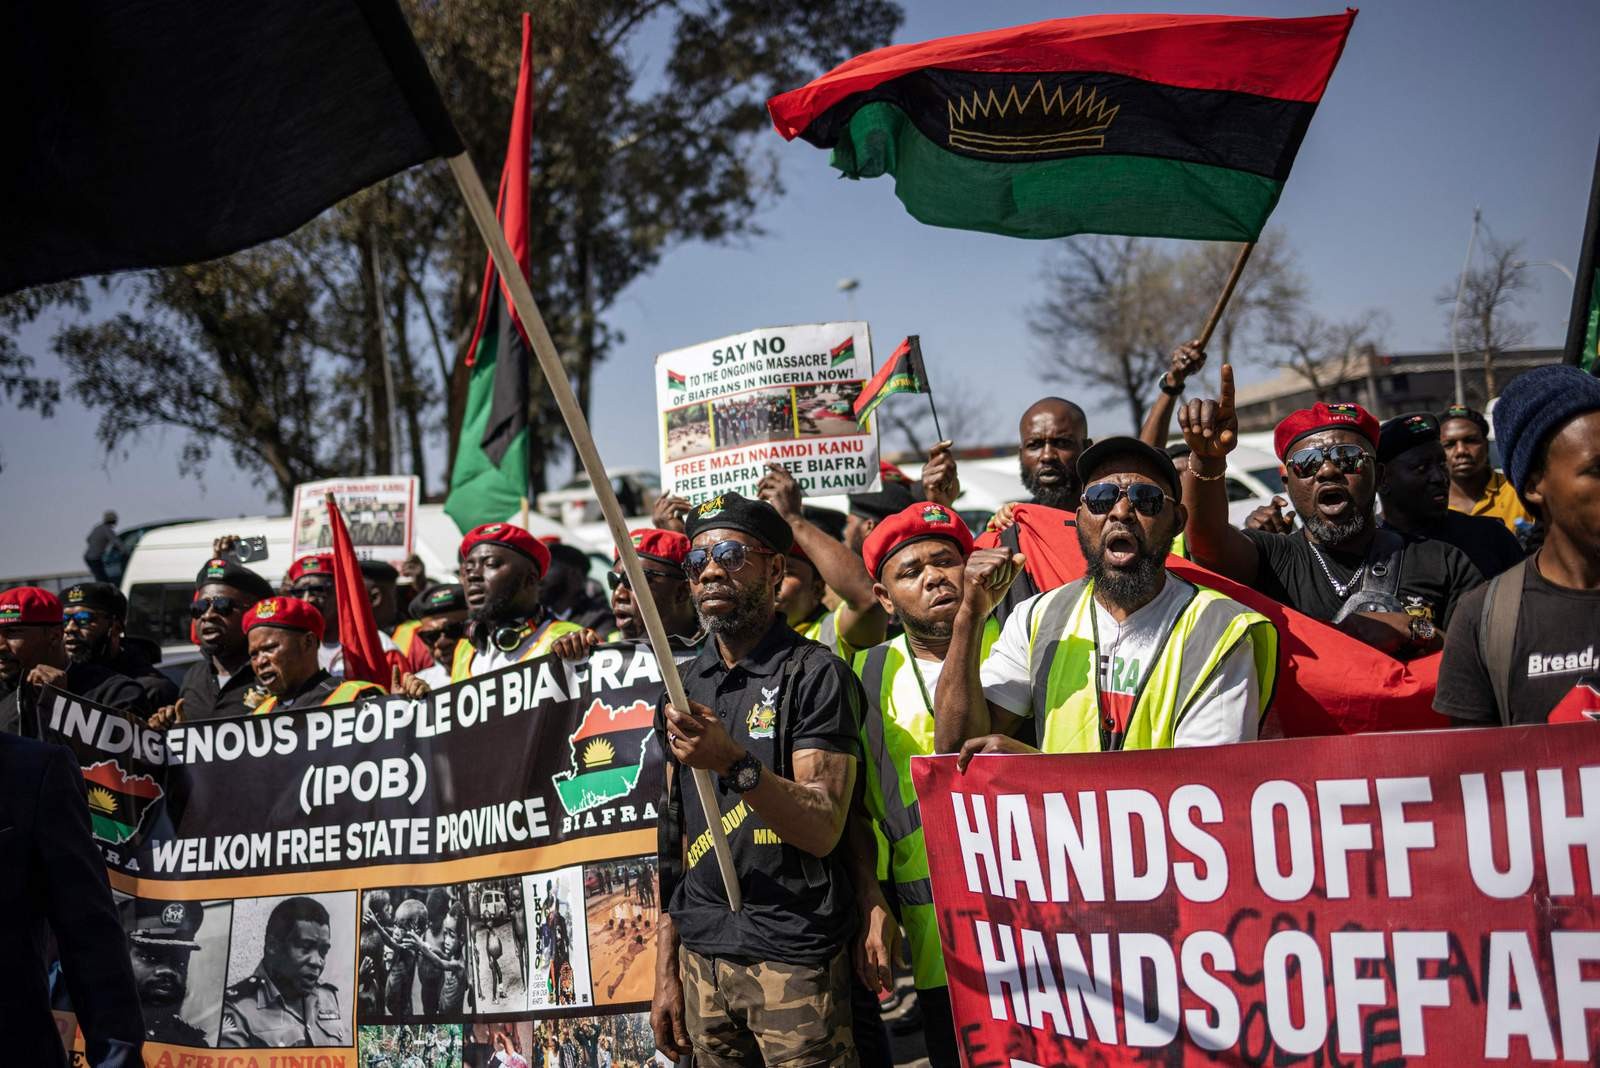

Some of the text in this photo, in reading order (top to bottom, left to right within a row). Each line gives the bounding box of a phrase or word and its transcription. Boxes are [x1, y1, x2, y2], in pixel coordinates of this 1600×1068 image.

[712, 336, 786, 366] SAY NO
[673, 368, 854, 406] OF BIAFRANS IN NIGERIA NOW!
[690, 354, 828, 387] TO THE ONGOING MASSACRE
[674, 439, 864, 477] FREE MAZI NNAMDI KANU
[675, 476, 708, 493] FREE
[710, 465, 759, 486] BIAFRA
[807, 454, 867, 472] BIAFRA
[820, 472, 867, 489] KANU
[49, 648, 663, 766] INDIGENOUS PEOPLE OF BIAFRA
[299, 752, 427, 815] (IPOB)
[152, 797, 550, 873] WELKOM FREE STATE PROVINCE
[562, 802, 658, 833] BIAFRA
[951, 765, 1600, 902] HANDS OFF UH
[753, 829, 782, 845] MN
[975, 920, 1241, 1051] HANDS
[1263, 929, 1451, 1057] OFF
[1484, 930, 1600, 1062] AF
[156, 1050, 346, 1068] AFRICA UNION
